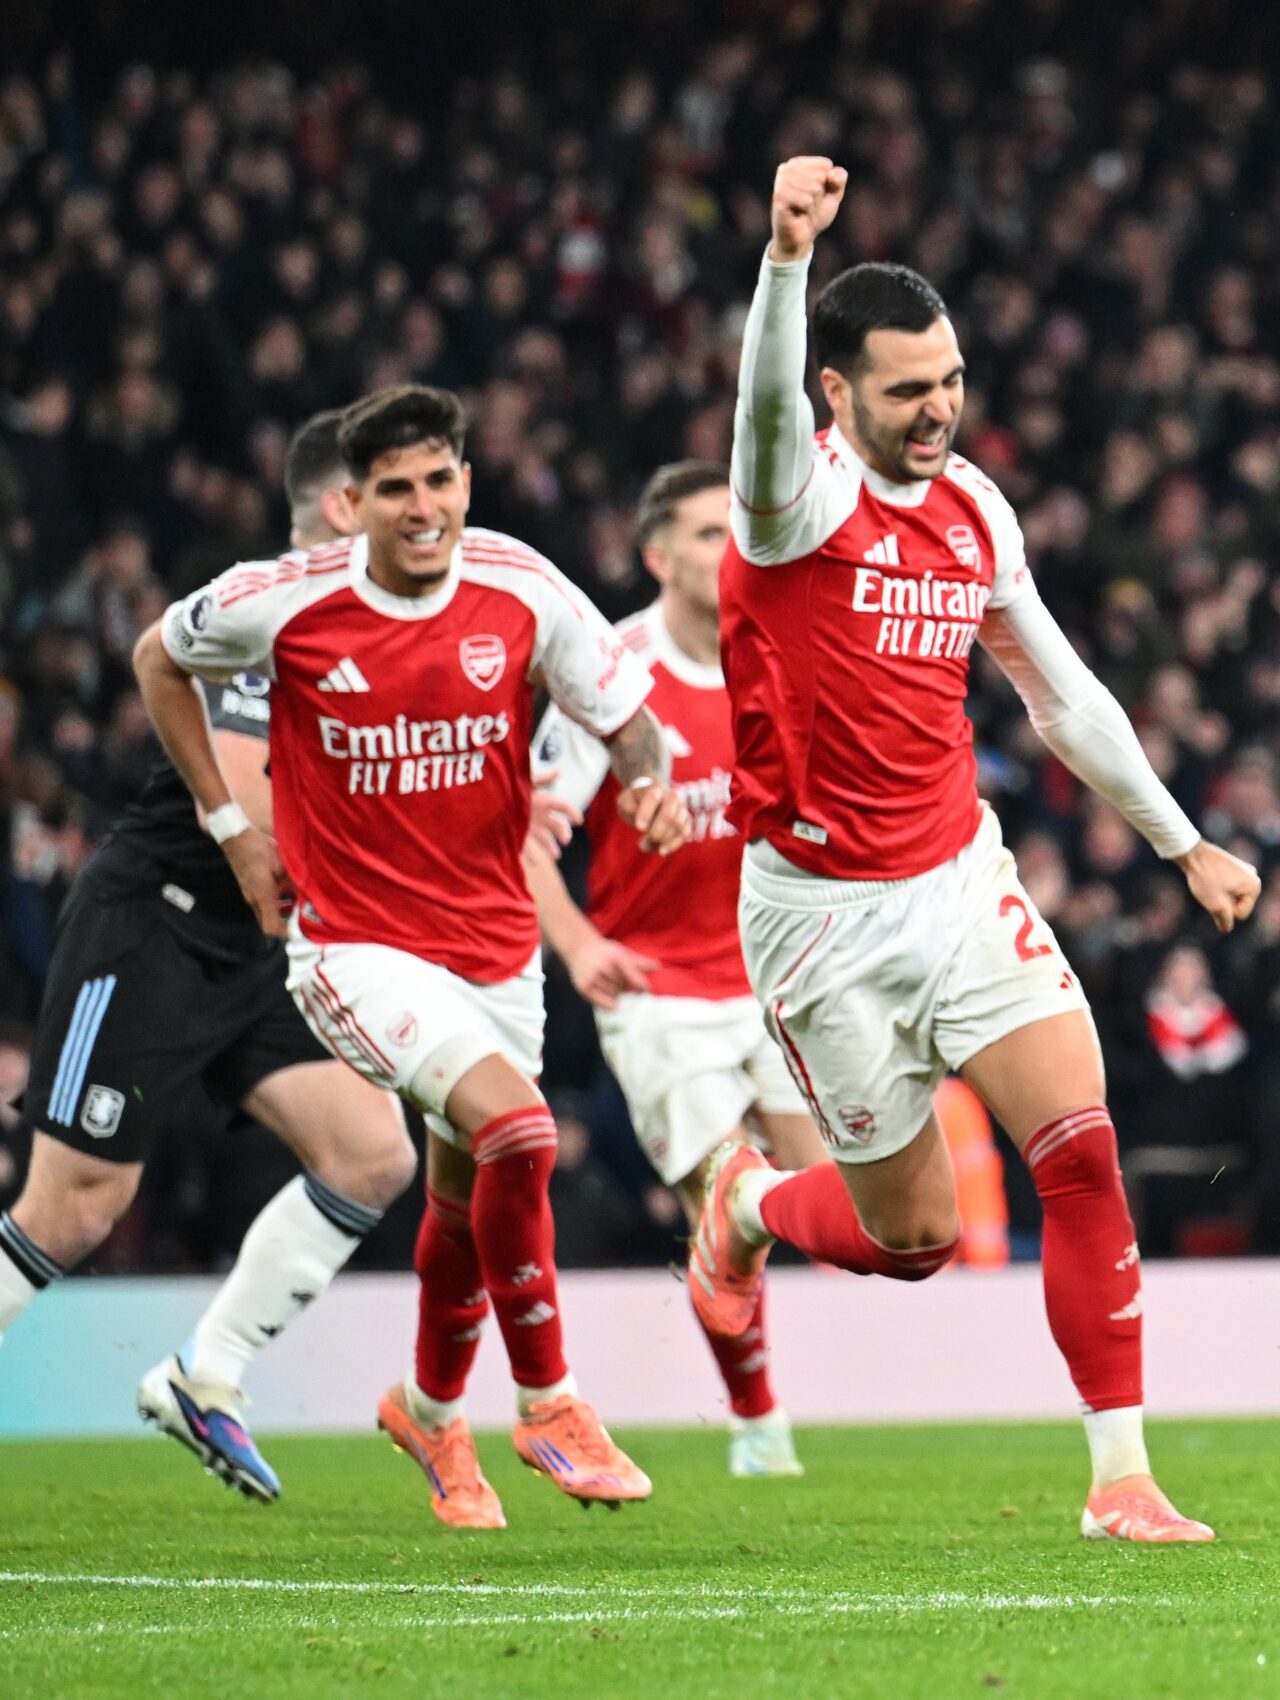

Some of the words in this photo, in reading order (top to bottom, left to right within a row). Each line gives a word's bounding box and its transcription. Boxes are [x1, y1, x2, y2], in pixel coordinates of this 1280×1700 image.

[875, 616, 918, 656] FLY
[318, 710, 510, 760] Emirates
[348, 761, 392, 796] FLY
[399, 750, 486, 795] BETTER
